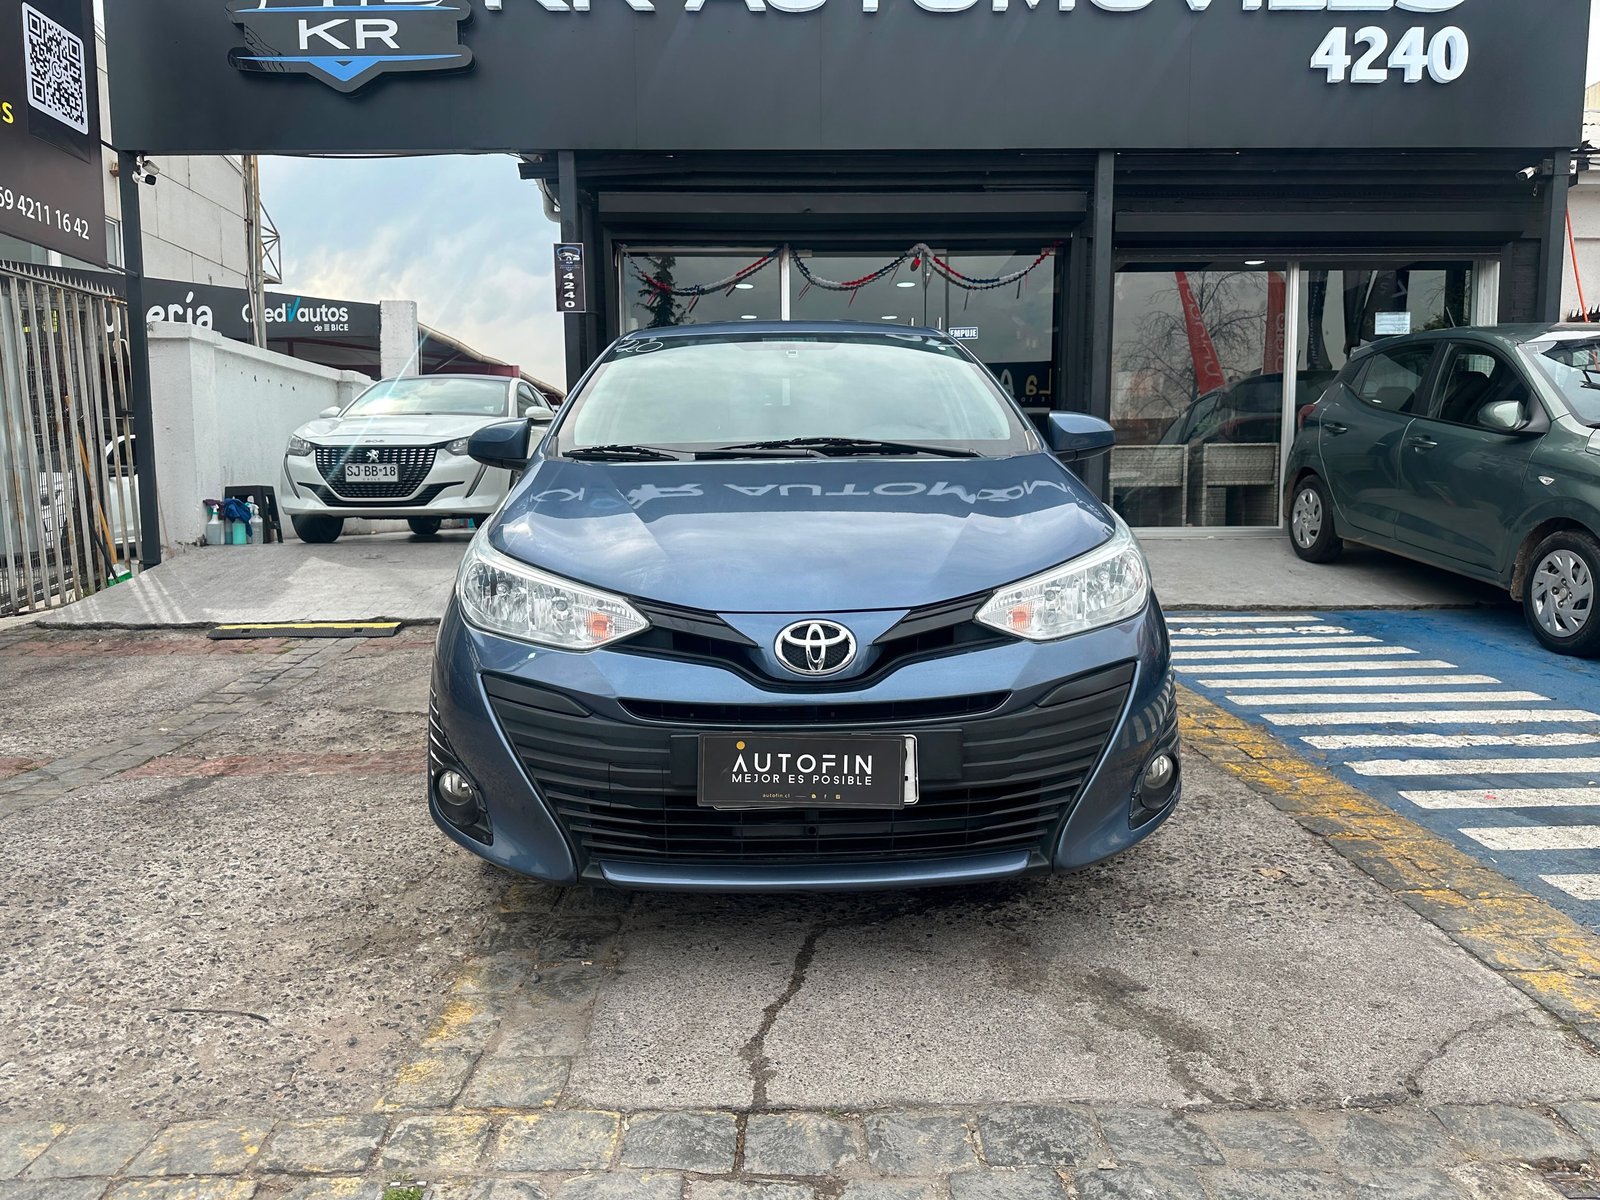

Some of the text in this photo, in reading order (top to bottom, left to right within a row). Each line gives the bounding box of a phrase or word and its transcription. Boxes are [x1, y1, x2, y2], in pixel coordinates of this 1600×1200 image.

[298, 18, 401, 50] KR
[1310, 25, 1469, 84] 4240
[17, 194, 50, 225] 4211
[563, 272, 576, 308] 4240
[313, 323, 349, 332] de BICE
[950, 328, 978, 338] EMPUJE
[731, 752, 873, 775] AUTOFIN
[731, 773, 872, 786] MEJOR ES POSIBLE
